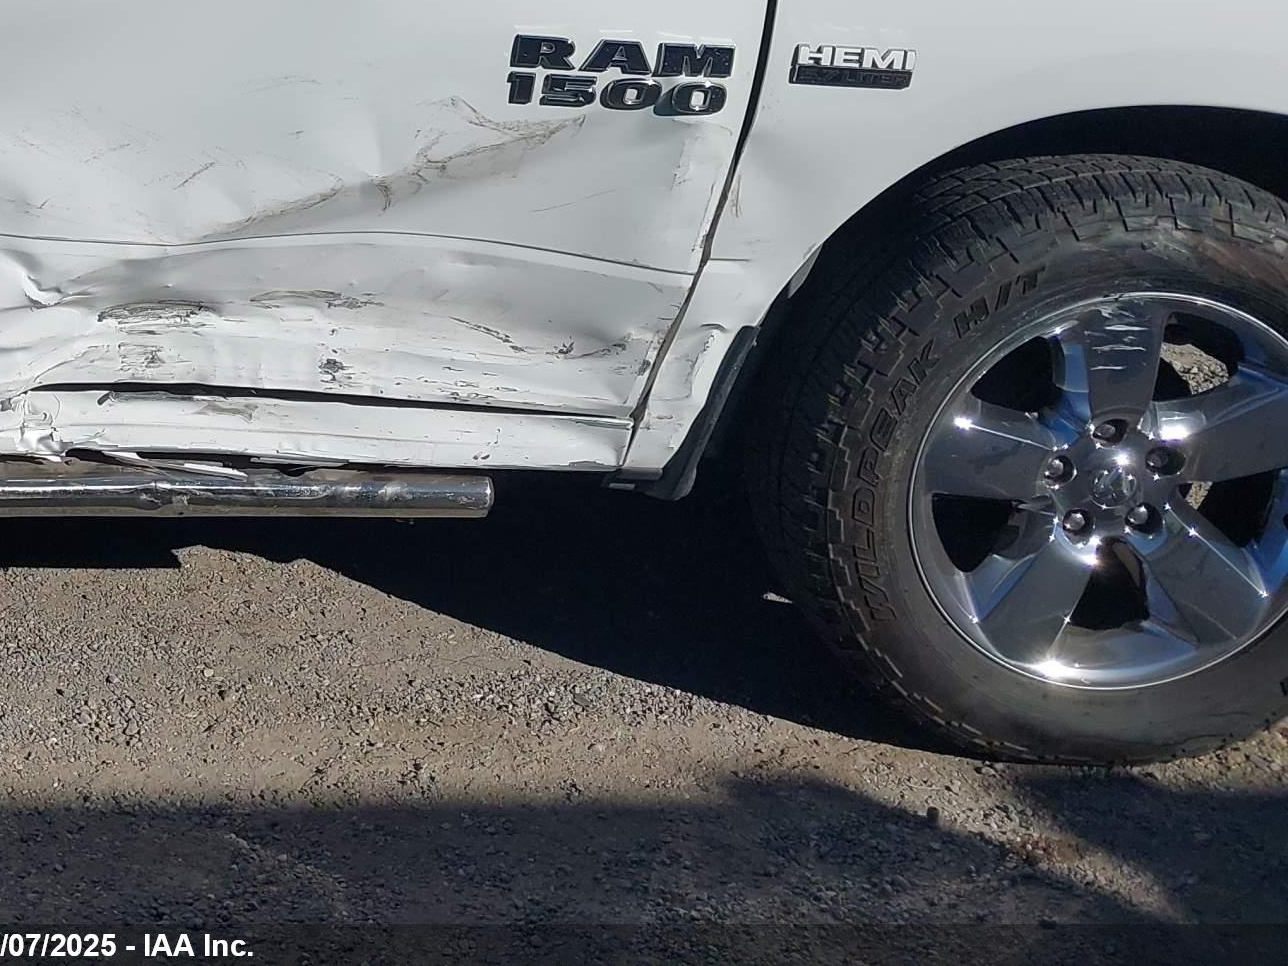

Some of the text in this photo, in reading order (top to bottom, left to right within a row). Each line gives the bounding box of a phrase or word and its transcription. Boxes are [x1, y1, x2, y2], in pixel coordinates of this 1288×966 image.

[510, 34, 736, 78] RAM
[791, 44, 916, 71] HEMI
[506, 71, 728, 117] 1500
[851, 338, 940, 622] WILDPEAK
